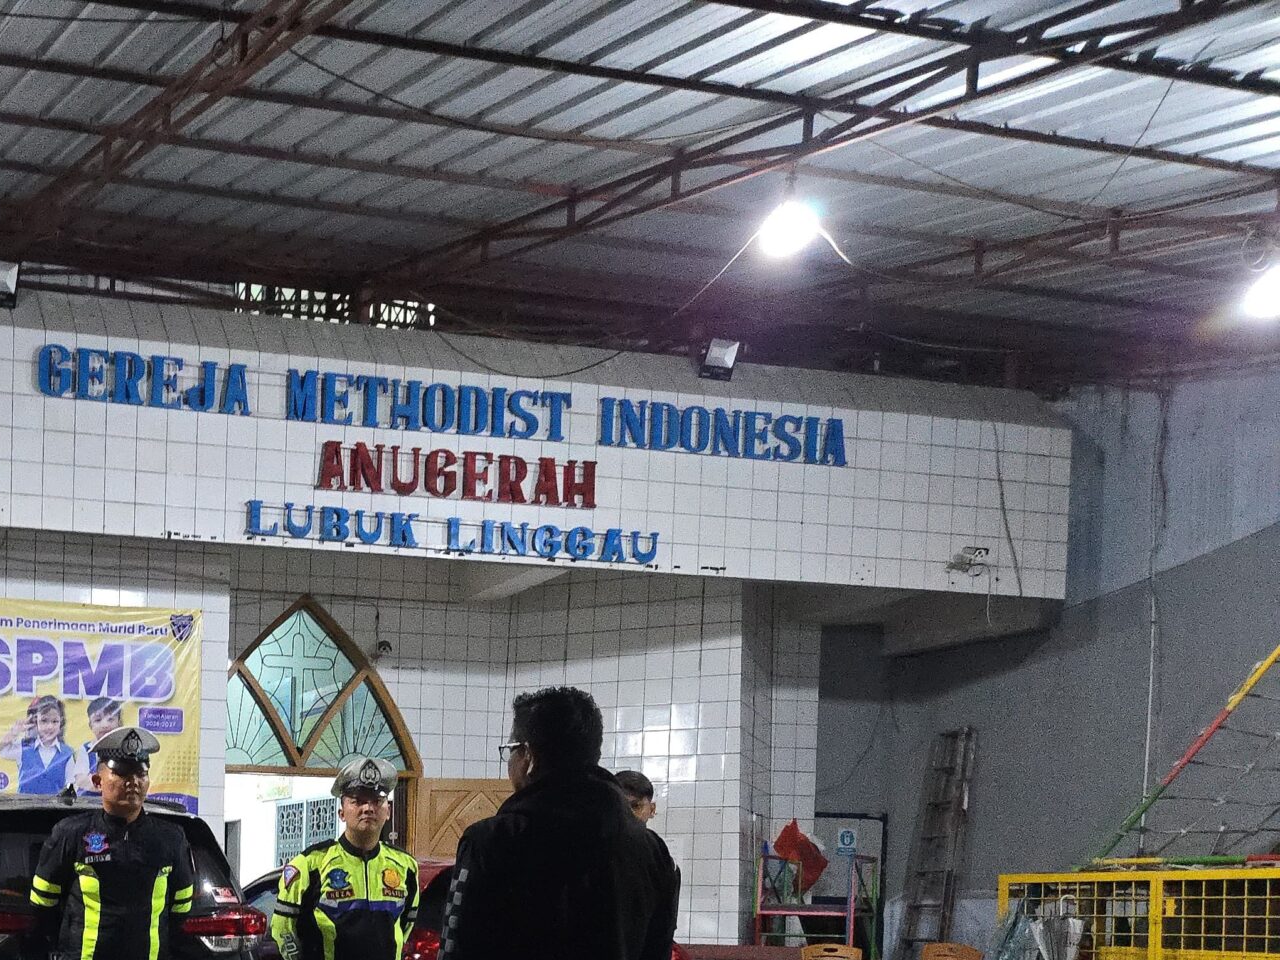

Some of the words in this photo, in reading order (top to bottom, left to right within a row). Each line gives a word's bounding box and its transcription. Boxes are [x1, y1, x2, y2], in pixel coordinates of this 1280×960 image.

[37, 343, 252, 416] GEREJA
[285, 368, 572, 442] METHODIST
[598, 396, 848, 467] INDONESIA
[317, 439, 598, 510] ANUGERAH
[244, 499, 420, 549] LUBUK
[445, 516, 661, 565] LINGGAU
[16, 618, 96, 632] Penerimaan
[98, 622, 135, 635] Murid
